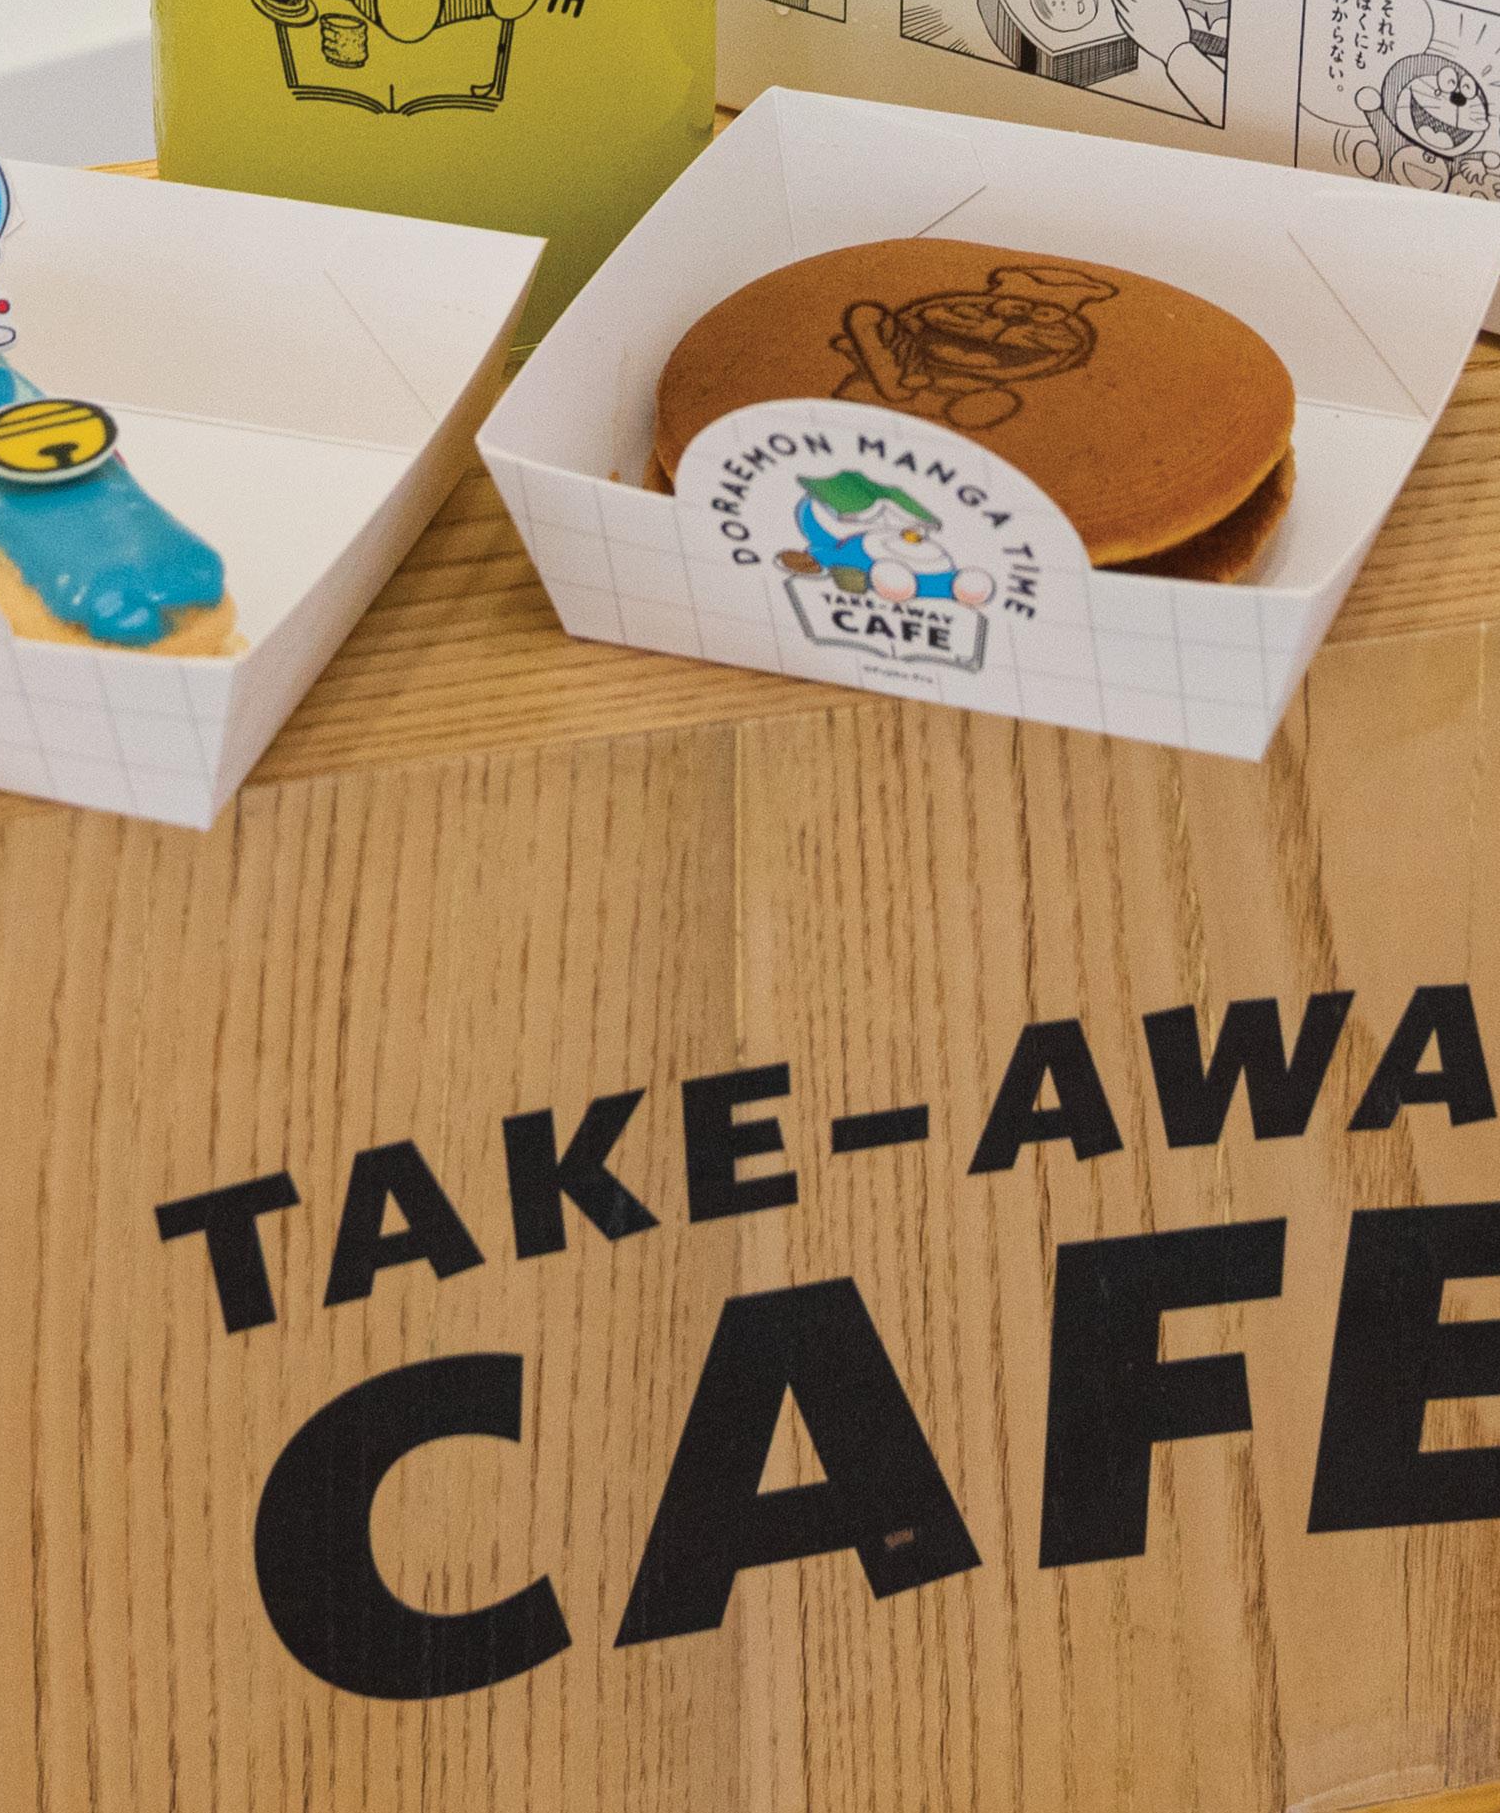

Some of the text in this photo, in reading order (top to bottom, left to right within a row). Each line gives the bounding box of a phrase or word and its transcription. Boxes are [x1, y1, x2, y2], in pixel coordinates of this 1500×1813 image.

[711, 433, 1042, 621] DORAEMON MANGA TIME
[831, 610, 952, 652] CAFE
